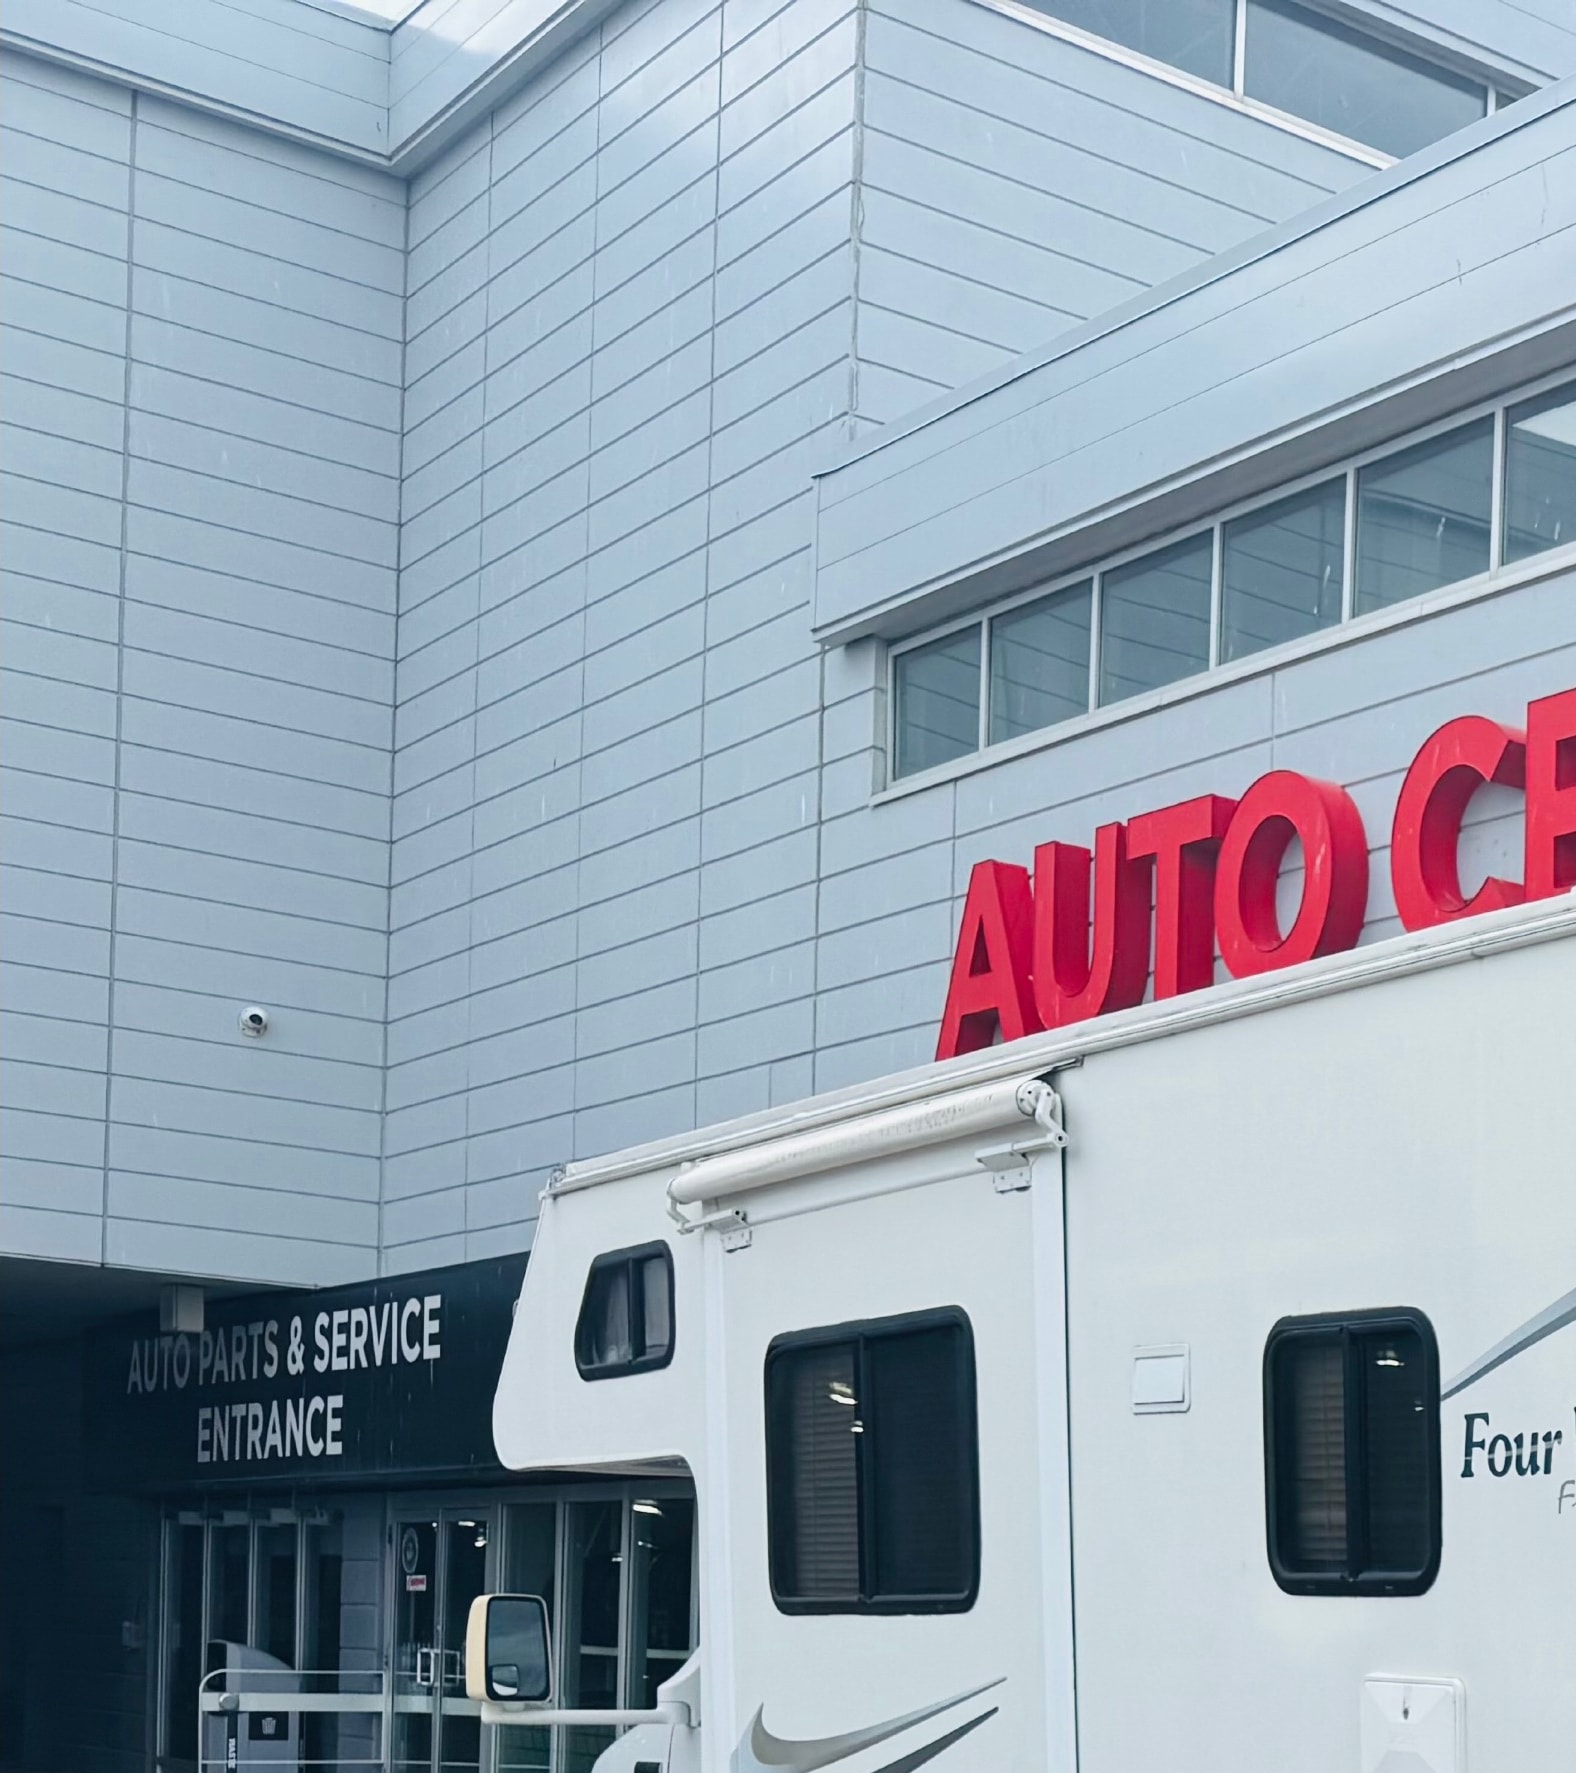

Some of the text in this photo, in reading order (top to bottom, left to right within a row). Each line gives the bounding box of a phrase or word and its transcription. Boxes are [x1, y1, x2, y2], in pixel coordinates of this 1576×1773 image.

[935, 770, 1370, 1061] AUTO
[127, 1294, 442, 1395] AUTO PARTS & SERVICE
[197, 1395, 344, 1463] ENTRANCE
[1460, 1412, 1562, 1478] Four
